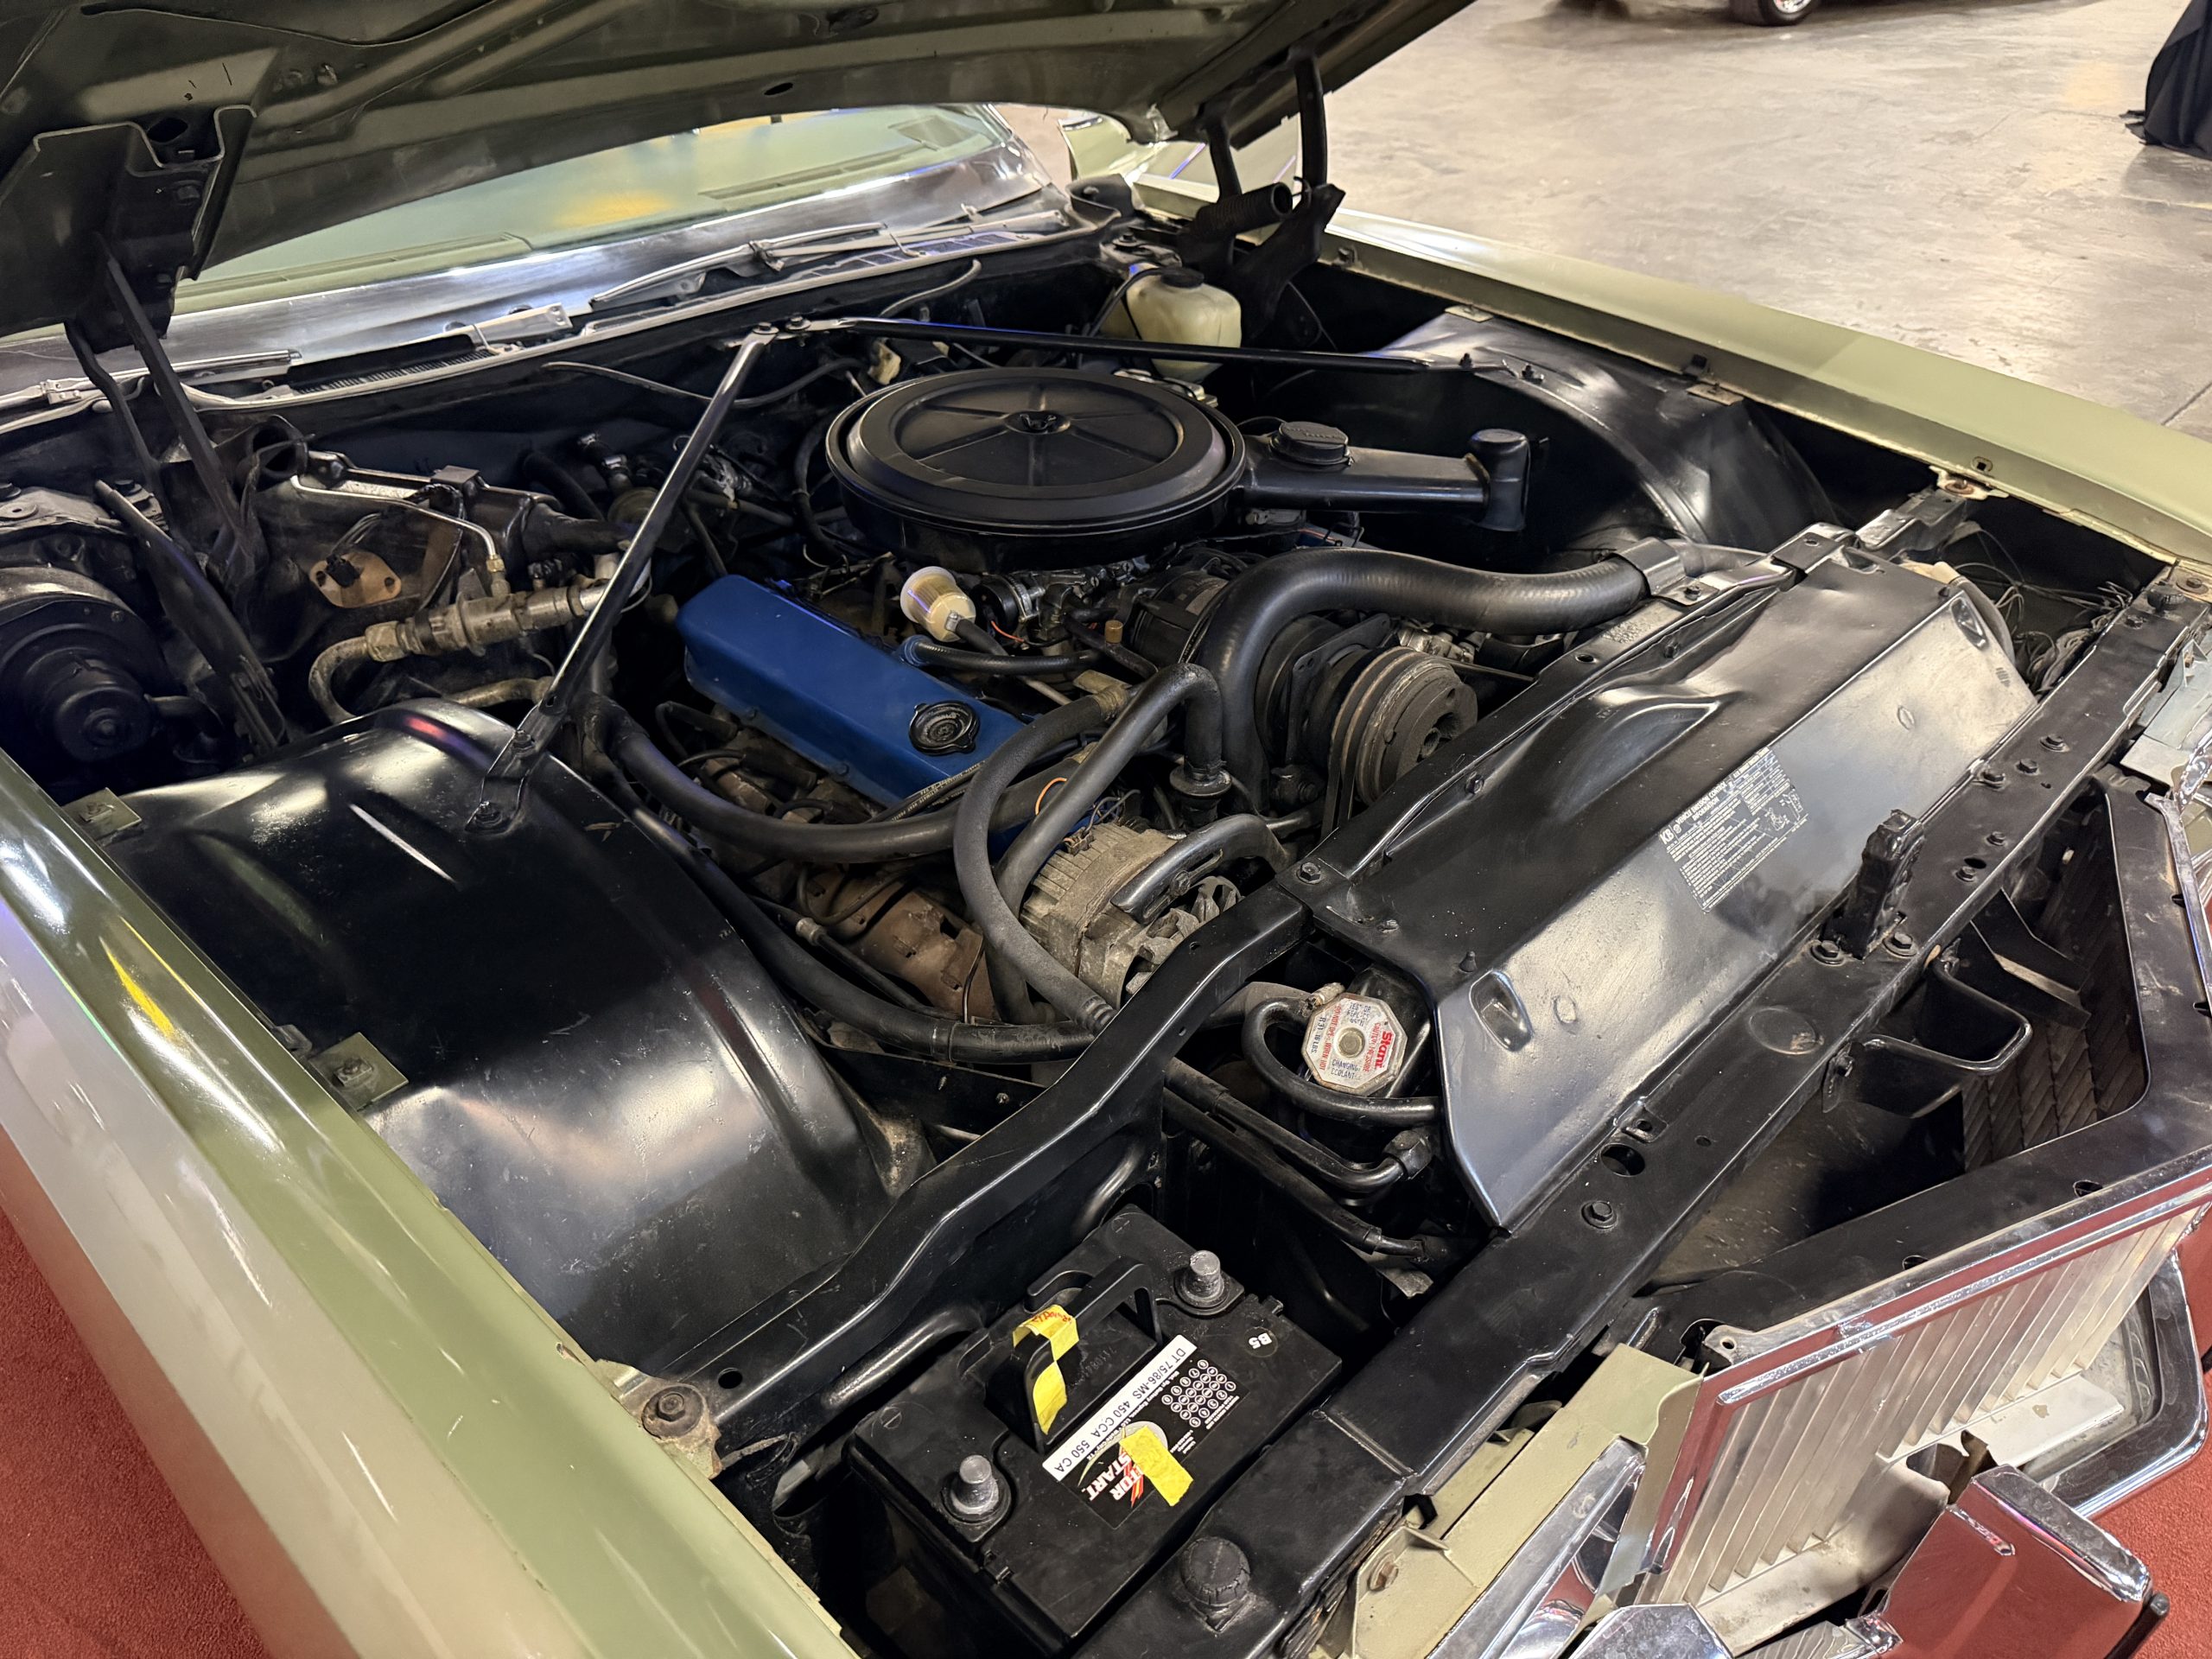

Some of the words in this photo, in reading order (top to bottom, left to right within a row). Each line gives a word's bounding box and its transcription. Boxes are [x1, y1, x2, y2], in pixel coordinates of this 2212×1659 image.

[1675, 810, 1693, 824] VEHICLE
[1690, 795, 1710, 812] EMISSION
[1708, 781, 1728, 798] CONTROL
[1692, 796, 1719, 821] INFORMATION
[1659, 828, 1675, 845] KB
[1249, 1332, 1273, 1349] B5
[1170, 1347, 1186, 1363] DT
[1131, 1360, 1173, 1400] 75/86-MS
[1113, 1400, 1132, 1419] 450
[1090, 1416, 1116, 1438] CCA
[1071, 1440, 1090, 1459] 550
[1053, 1456, 1072, 1473] CA
[1086, 1452, 1132, 1500] START
